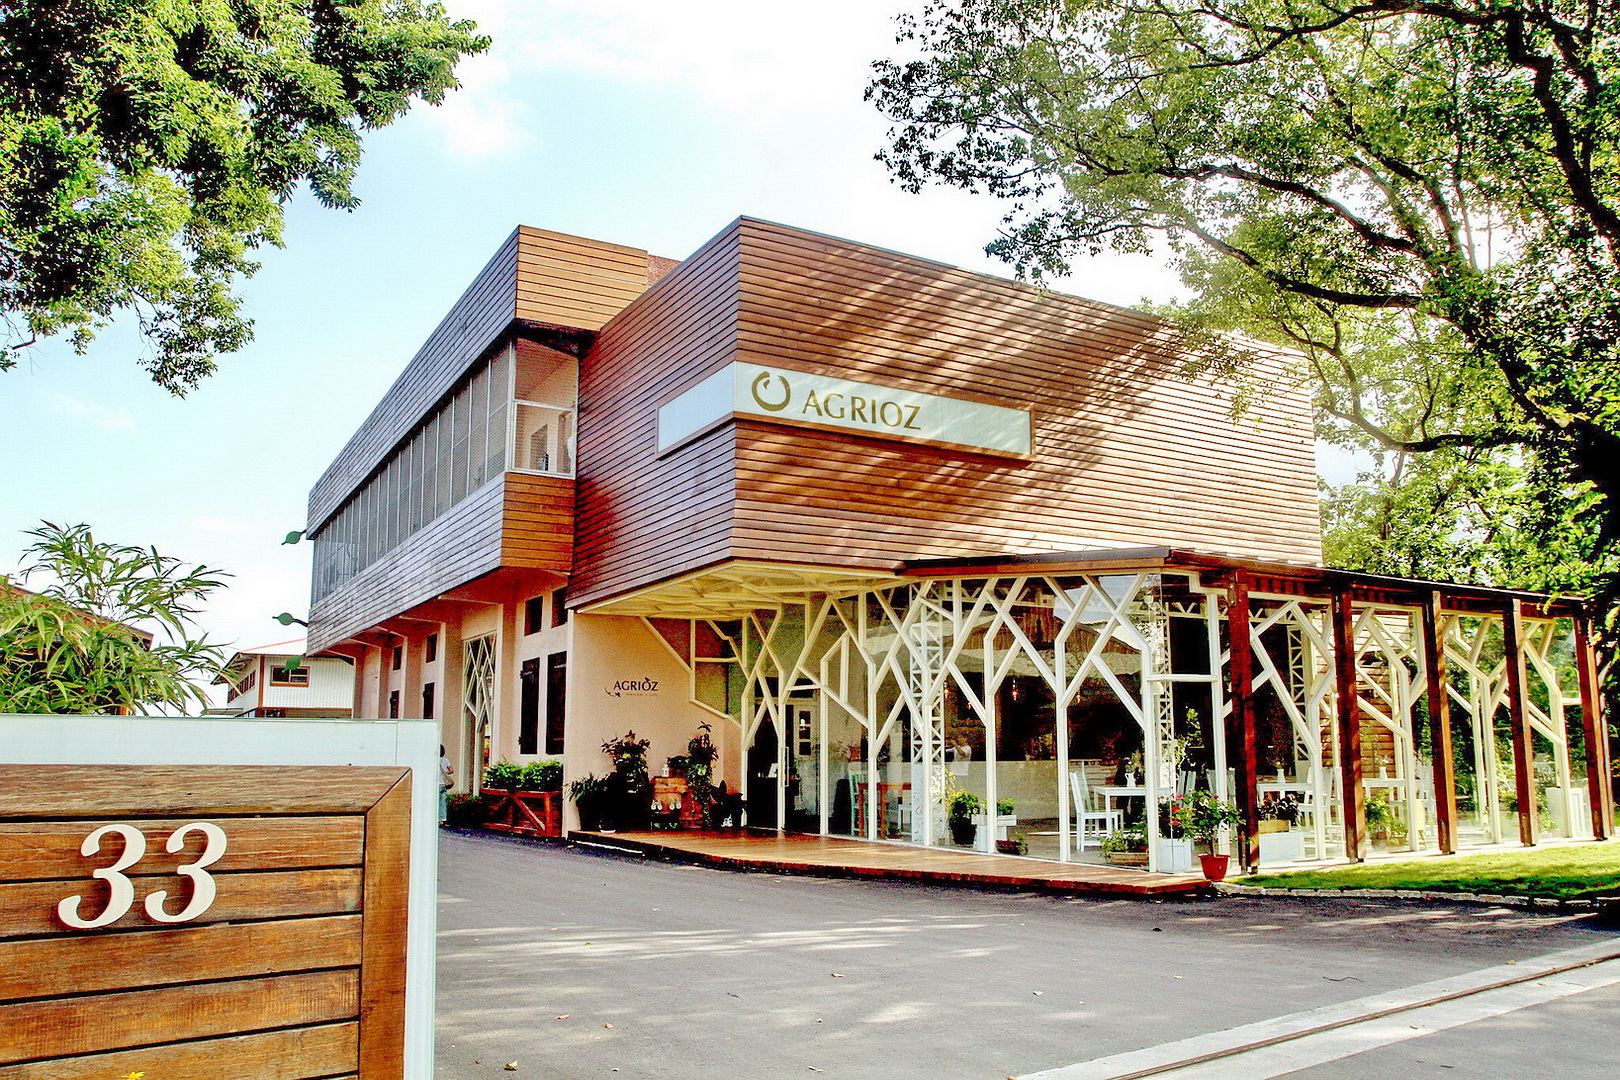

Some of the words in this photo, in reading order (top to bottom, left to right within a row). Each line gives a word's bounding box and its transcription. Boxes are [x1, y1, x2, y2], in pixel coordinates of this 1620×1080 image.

[802, 389, 922, 430] AGRIOZ
[613, 679, 659, 691] AGRIOZ
[58, 822, 228, 928] 33
